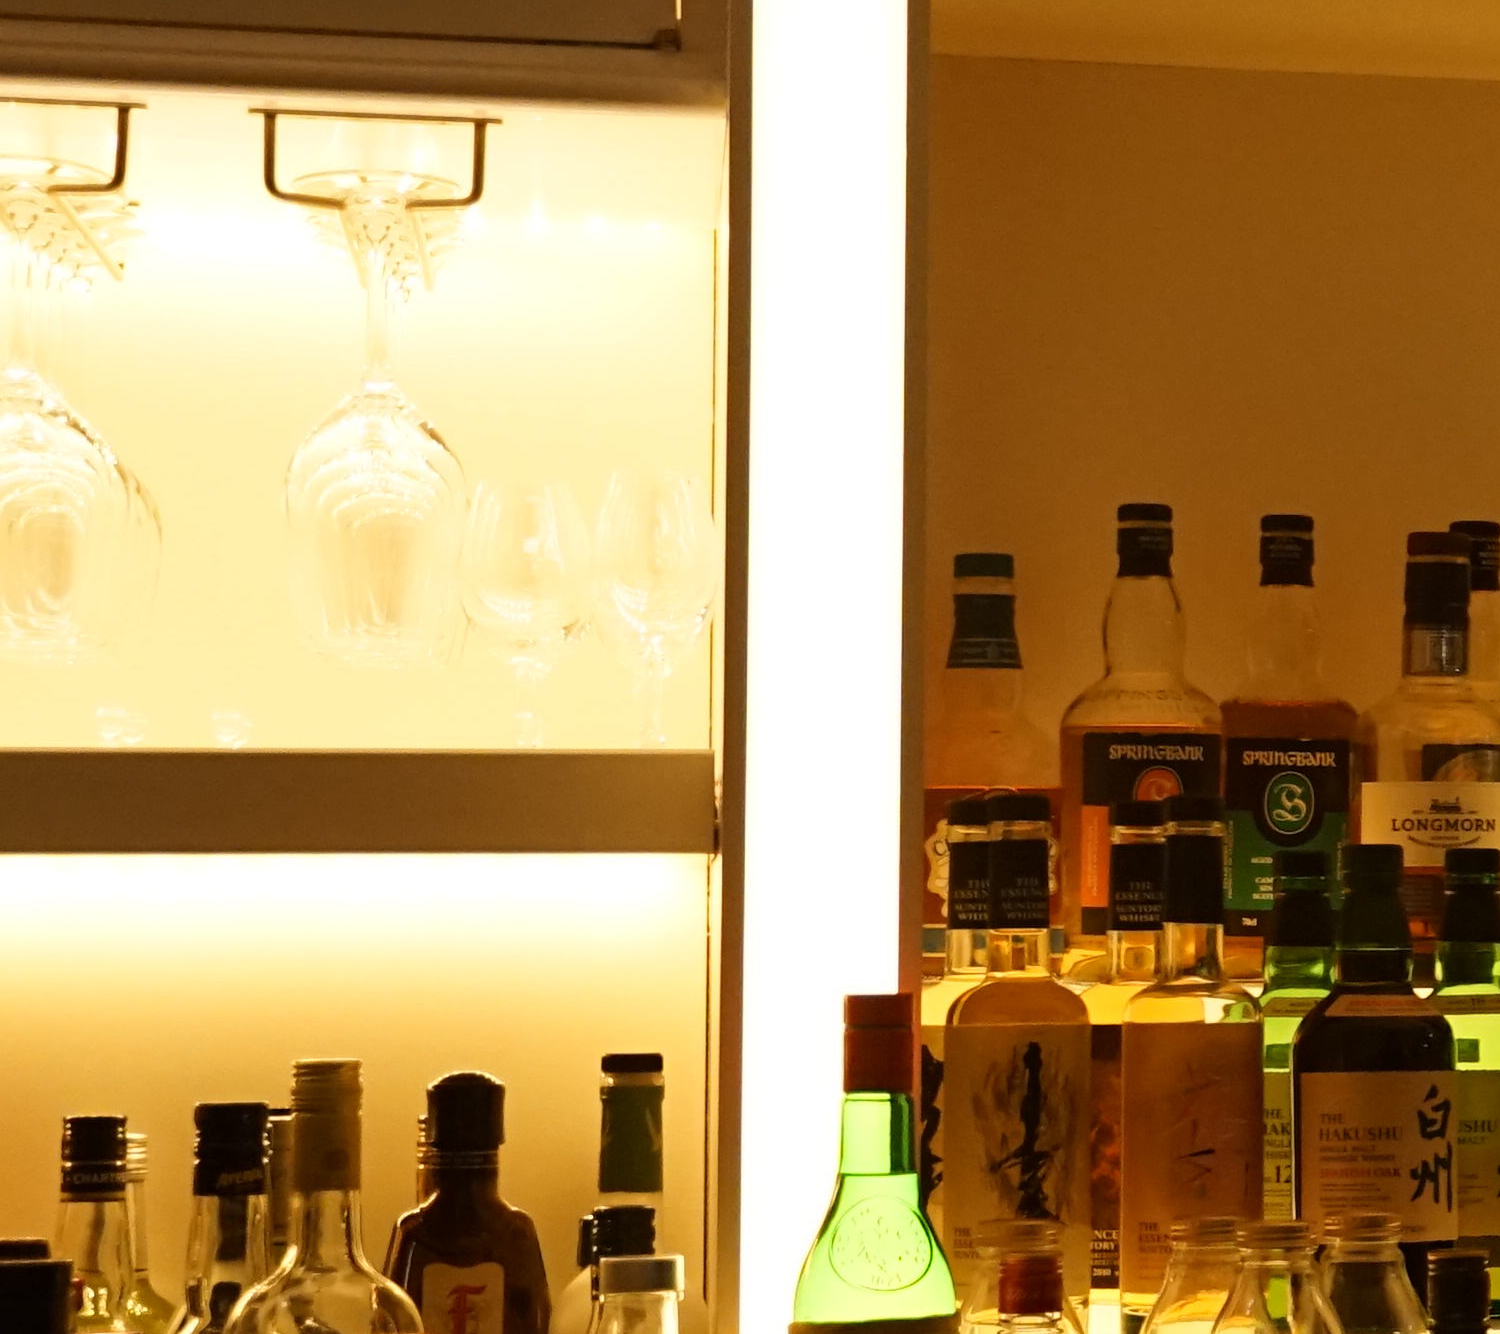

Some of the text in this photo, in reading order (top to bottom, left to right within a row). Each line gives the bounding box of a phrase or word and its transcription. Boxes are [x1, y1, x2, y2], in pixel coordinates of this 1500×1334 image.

[1109, 743, 1204, 762] SPRINGBANK
[1242, 750, 1337, 768] SPRINGBANK
[1390, 818, 1497, 833] LONGMORN
[1318, 1126, 1403, 1142] HAKUSHU
[1409, 1083, 1454, 1215] 白州
